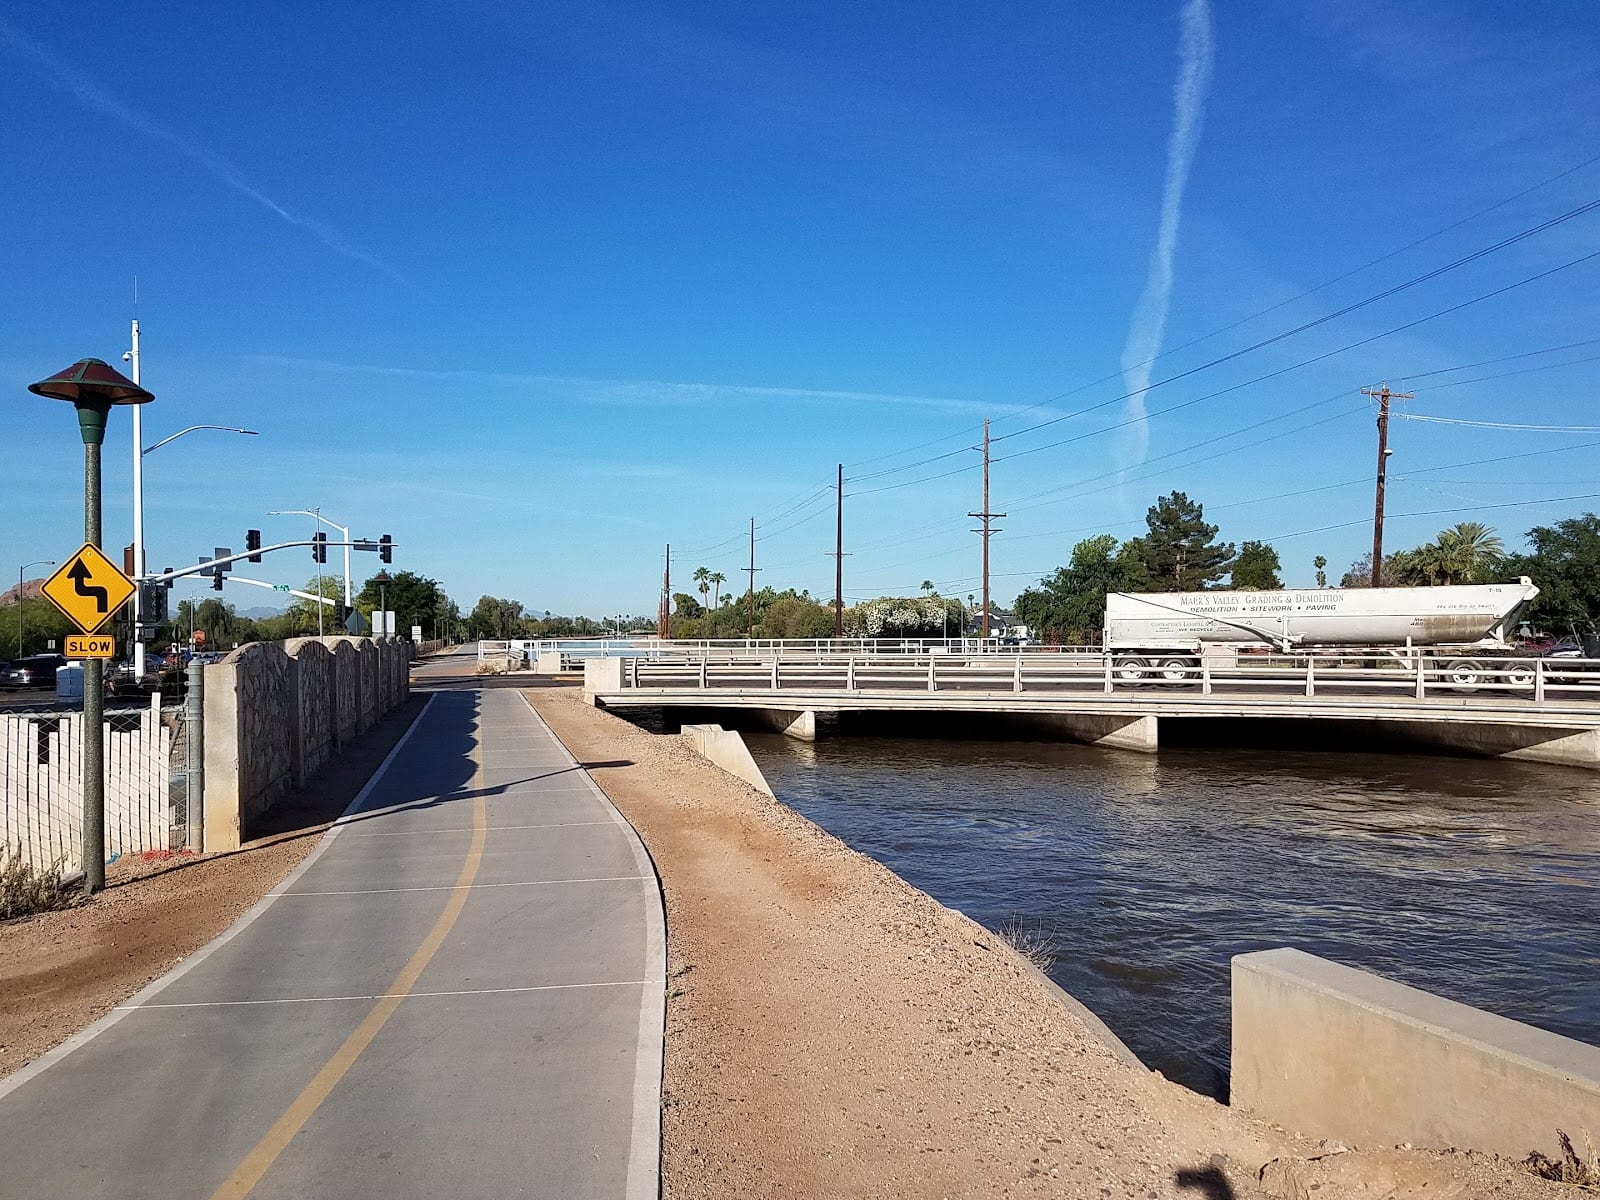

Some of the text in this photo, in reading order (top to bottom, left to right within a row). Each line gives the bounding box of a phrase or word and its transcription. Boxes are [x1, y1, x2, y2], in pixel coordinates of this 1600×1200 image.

[1213, 595, 1240, 605] VALLEY
[1245, 594, 1282, 604] GRADING
[1286, 595, 1292, 603] &
[1296, 593, 1344, 603] DEMOLITION
[70, 641, 110, 652] SLOW
